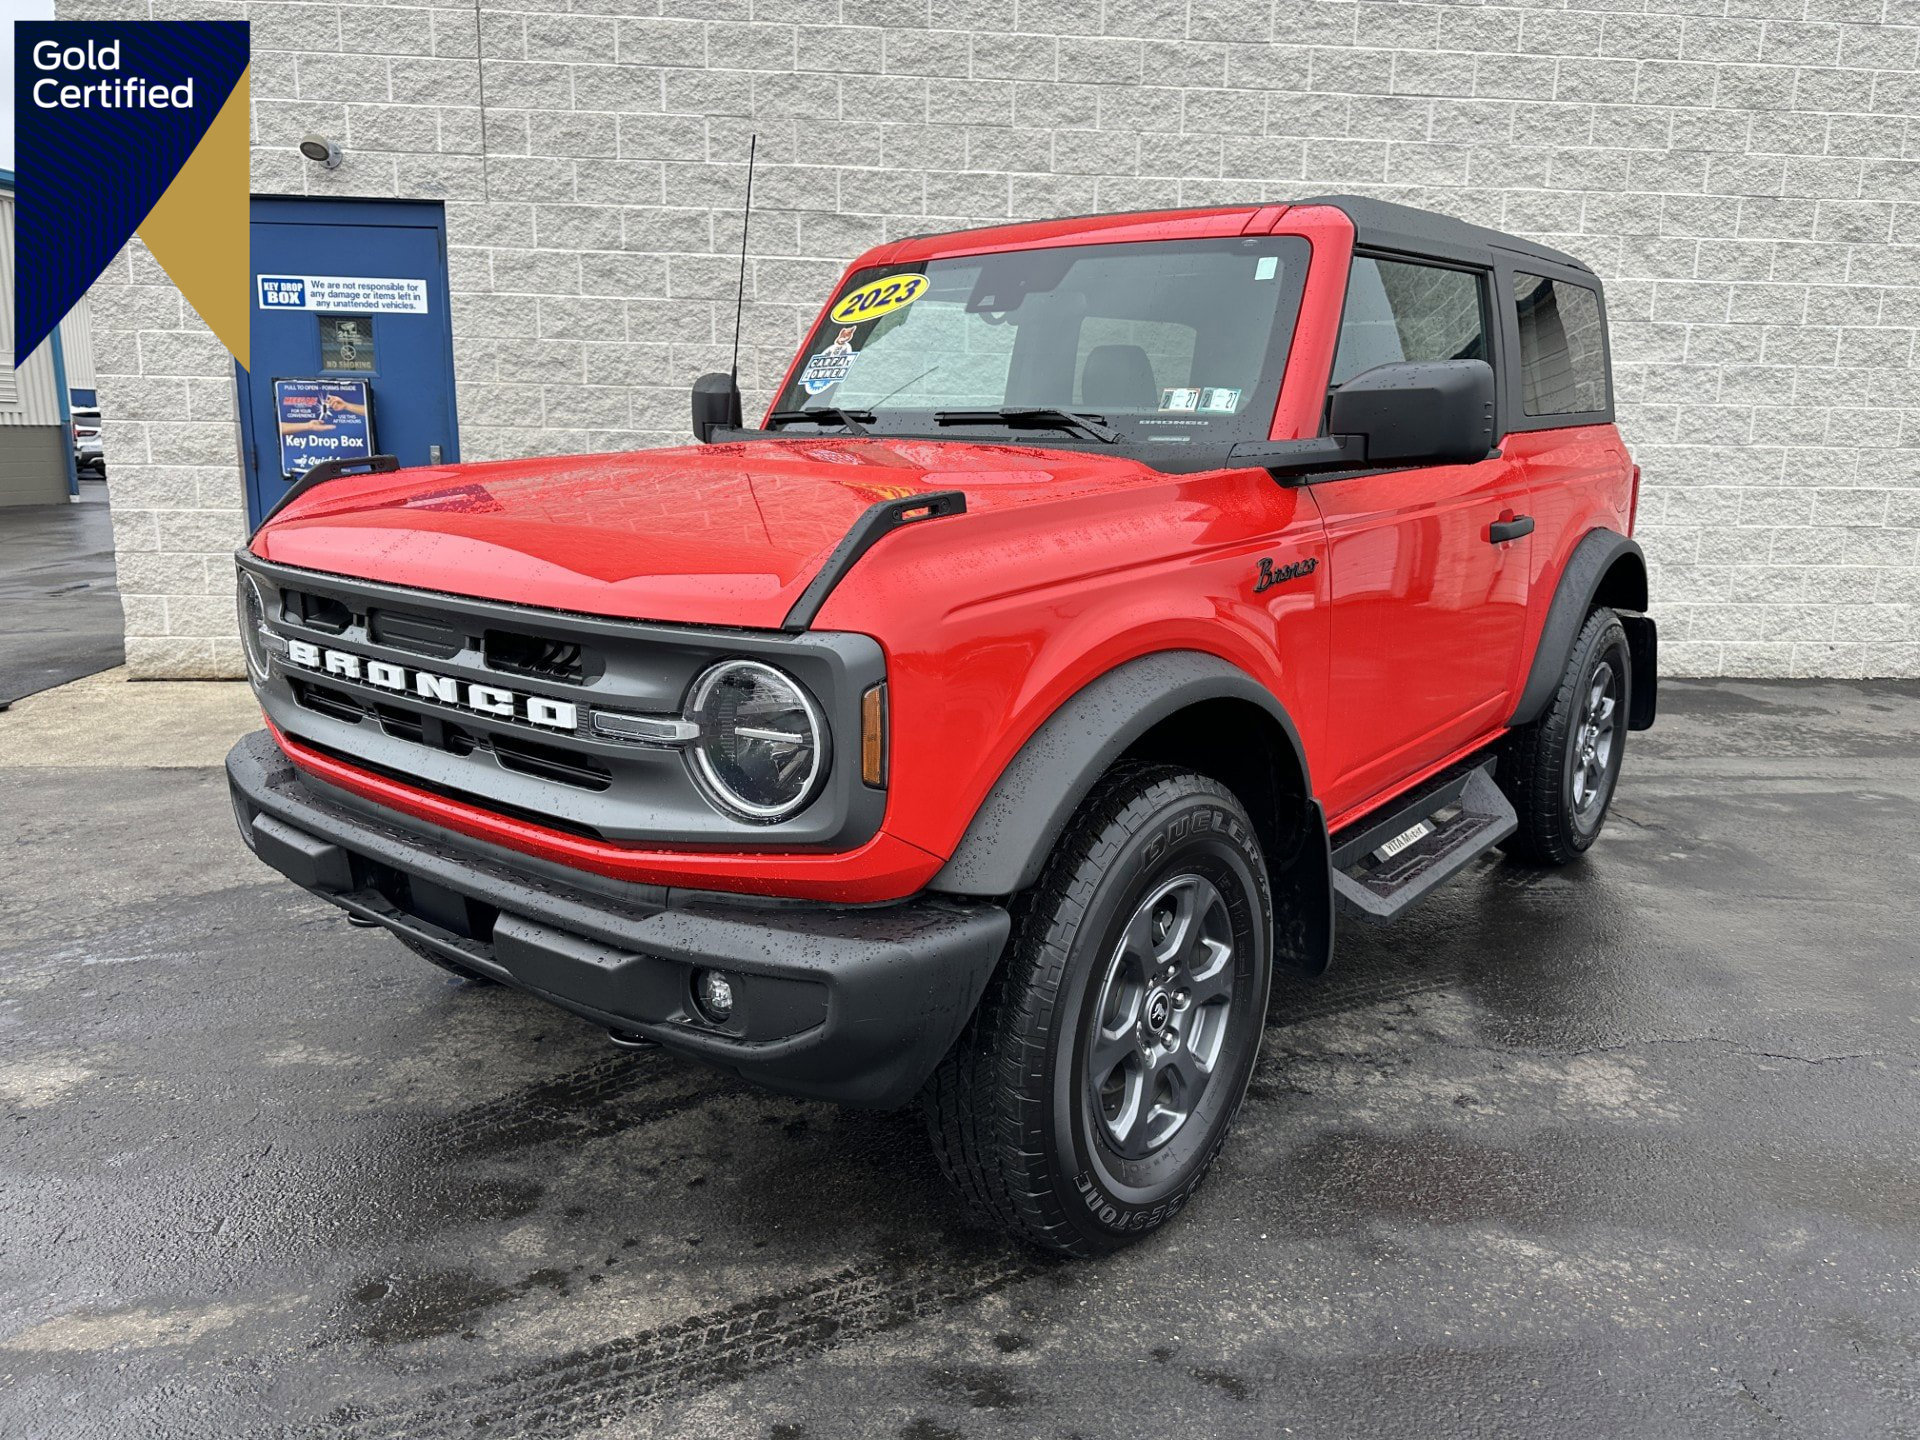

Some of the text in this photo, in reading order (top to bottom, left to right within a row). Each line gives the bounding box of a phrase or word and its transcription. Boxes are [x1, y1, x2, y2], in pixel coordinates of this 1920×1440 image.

[263, 282, 303, 292] KEY DROP
[311, 280, 419, 293] We are not responsible for
[267, 291, 300, 304] BOX
[310, 290, 325, 299] any
[327, 289, 361, 301] damage
[373, 291, 396, 301] items
[398, 292, 411, 301] left
[413, 293, 421, 301] in
[838, 279, 921, 318] 2023
[316, 298, 416, 310] any unattended vehicles.
[811, 368, 847, 379] OWNER
[1185, 392, 1197, 408] 27
[1225, 392, 1238, 409] 27
[285, 434, 364, 449] Key Drop Box
[1253, 556, 1319, 593] Bronco
[289, 638, 578, 730] BRONCO
[1142, 808, 1259, 874] DUELER
